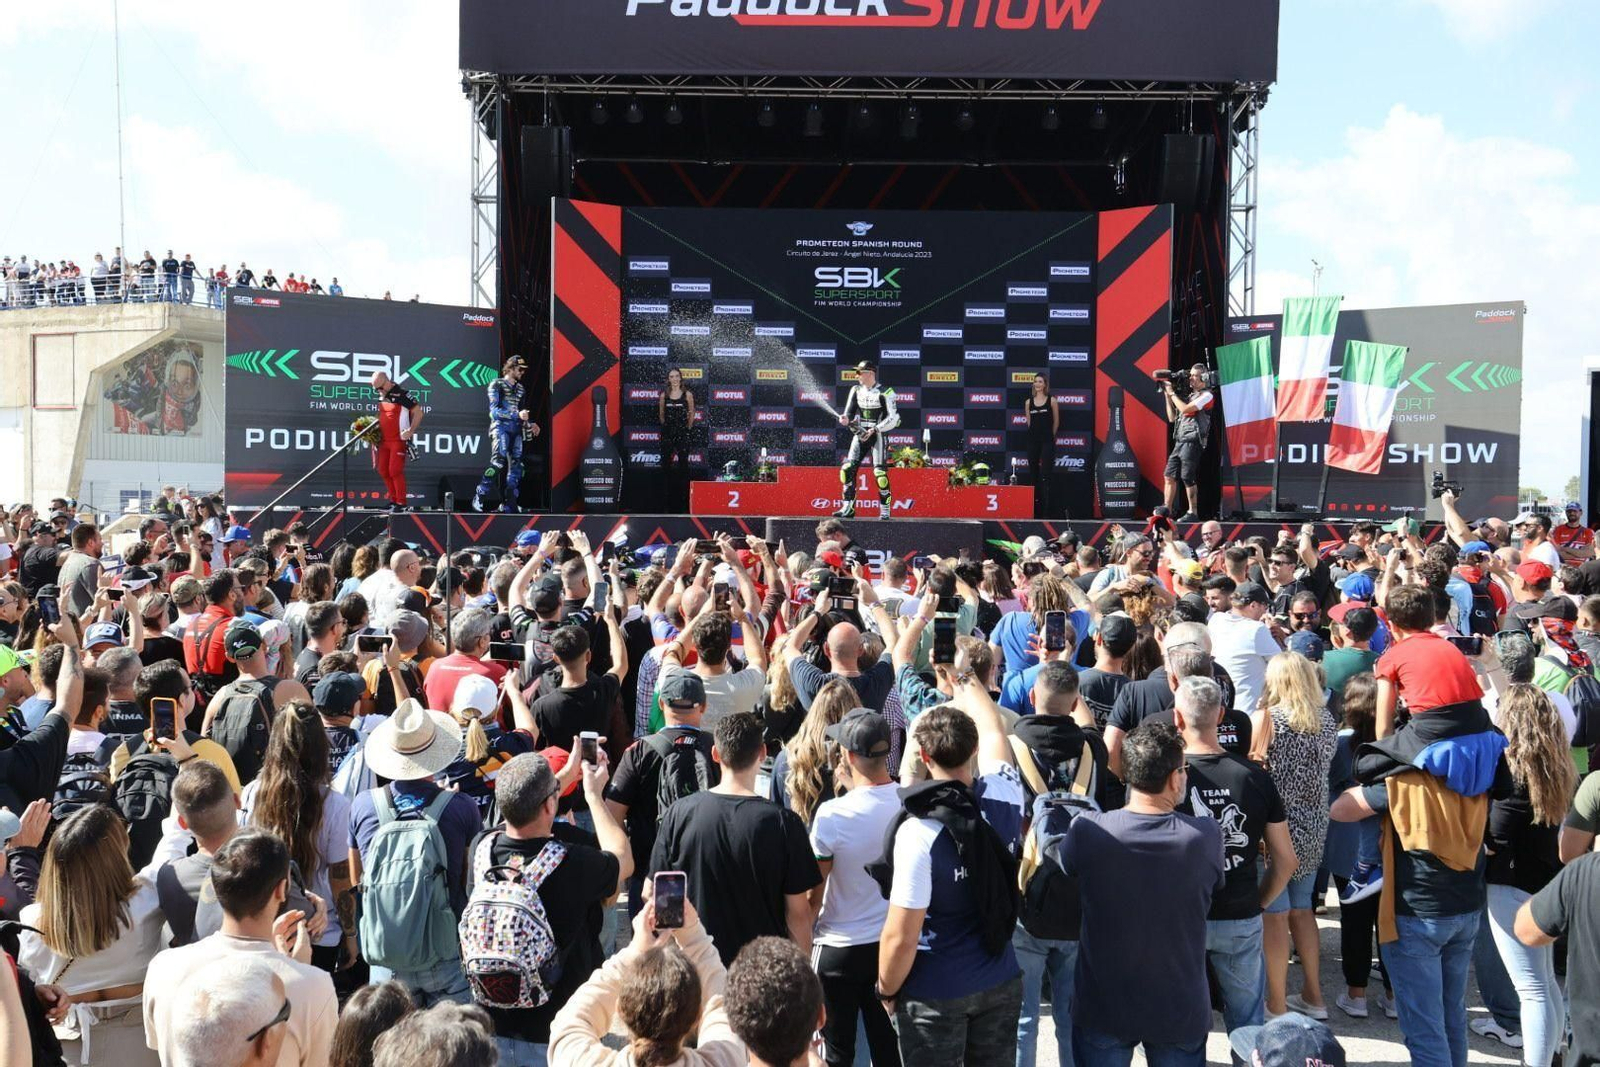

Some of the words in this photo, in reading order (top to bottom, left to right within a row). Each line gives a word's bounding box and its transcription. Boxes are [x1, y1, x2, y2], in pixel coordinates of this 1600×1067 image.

[796, 239, 850, 248] PROMETEON
[852, 240, 890, 248] SPANISH
[892, 241, 923, 249] ROUND
[814, 266, 901, 288] SBK
[814, 289, 901, 300] SUPERSPORT
[462, 313, 495, 322] Paddock
[1475, 309, 1516, 318] Paddock
[310, 350, 432, 386] SBK
[310, 384, 432, 402] SUPERSRT
[716, 391, 744, 399] MOTUL
[893, 393, 915, 401] OTUL
[310, 402, 328, 410] FIM
[331, 402, 362, 411] WORLD
[758, 413, 787, 421] MOTUL
[928, 415, 956, 423] MOTUL
[1390, 414, 1437, 422] PIONSHIP
[246, 428, 360, 452] PODIU
[412, 433, 481, 454] HOW
[716, 433, 744, 441] MOTUL
[1056, 438, 1085, 446] MOTUL
[1388, 442, 1498, 464] SHOW
[858, 474, 869, 490] 1
[728, 491, 740, 507] 2
[833, 499, 879, 508] HYNDA
[986, 494, 998, 511] 3
[1202, 788, 1230, 797] TEAM
